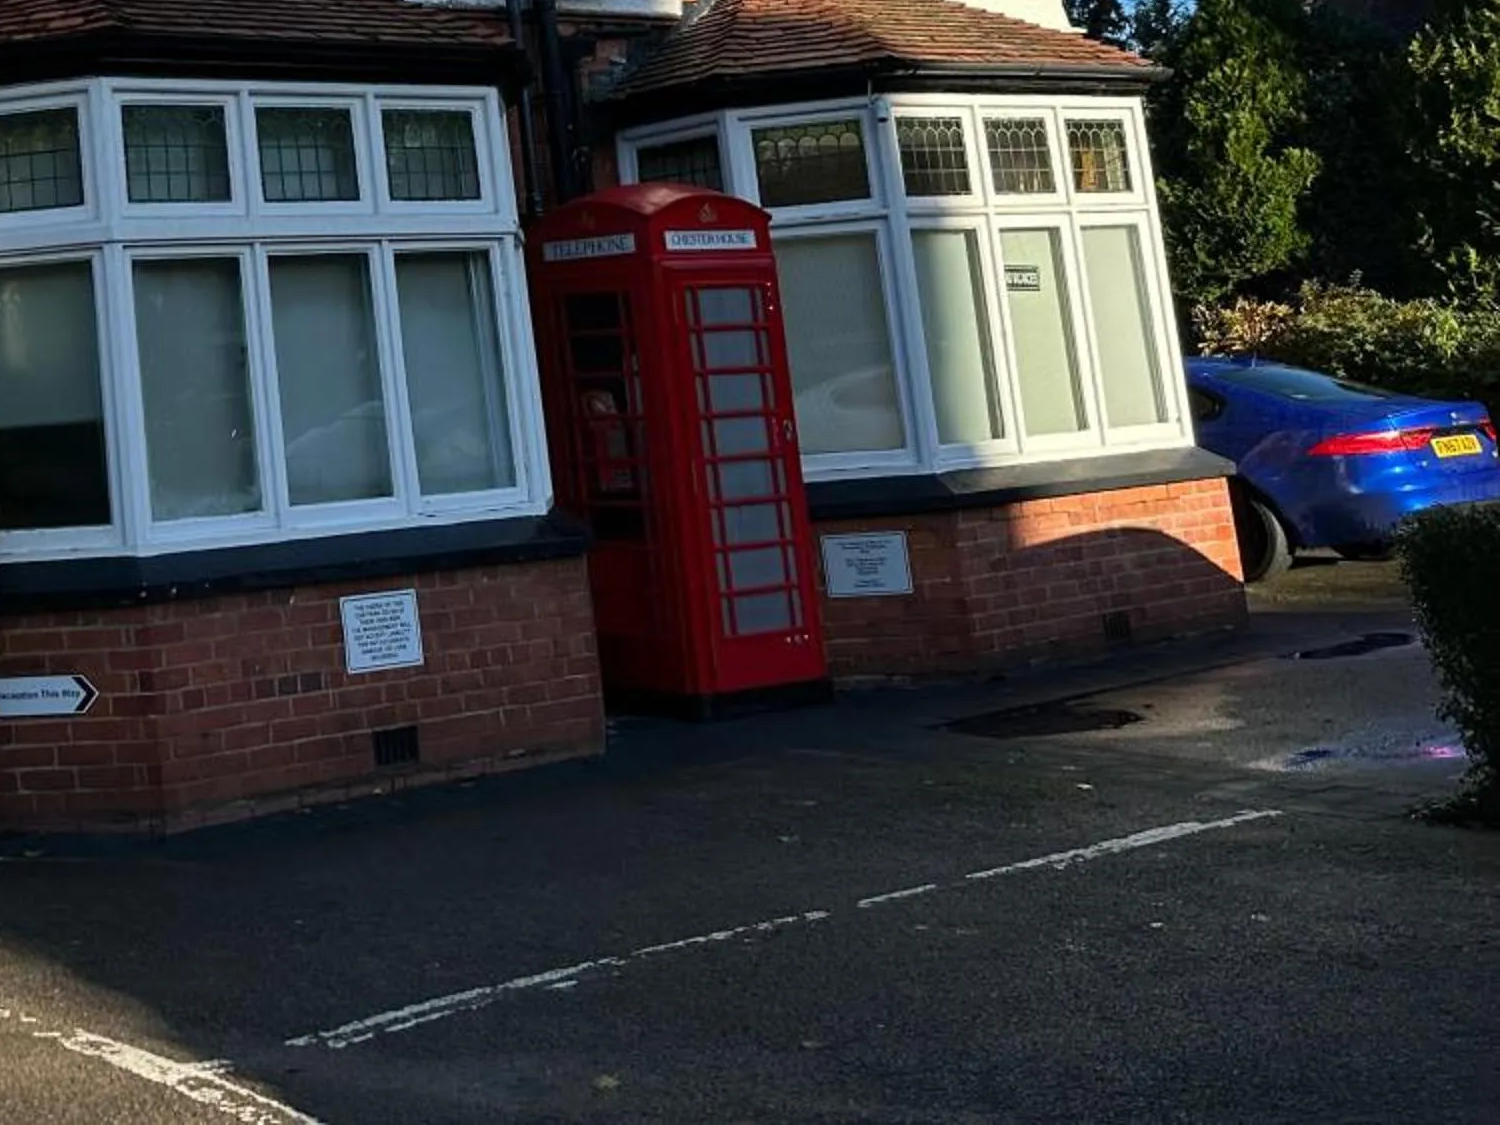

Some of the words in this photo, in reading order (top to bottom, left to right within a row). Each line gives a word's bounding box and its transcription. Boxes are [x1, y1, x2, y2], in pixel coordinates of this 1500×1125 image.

[553, 235, 628, 257] TELEPHONE
[671, 234, 715, 245] CHESTER
[716, 233, 747, 244] HOUSE
